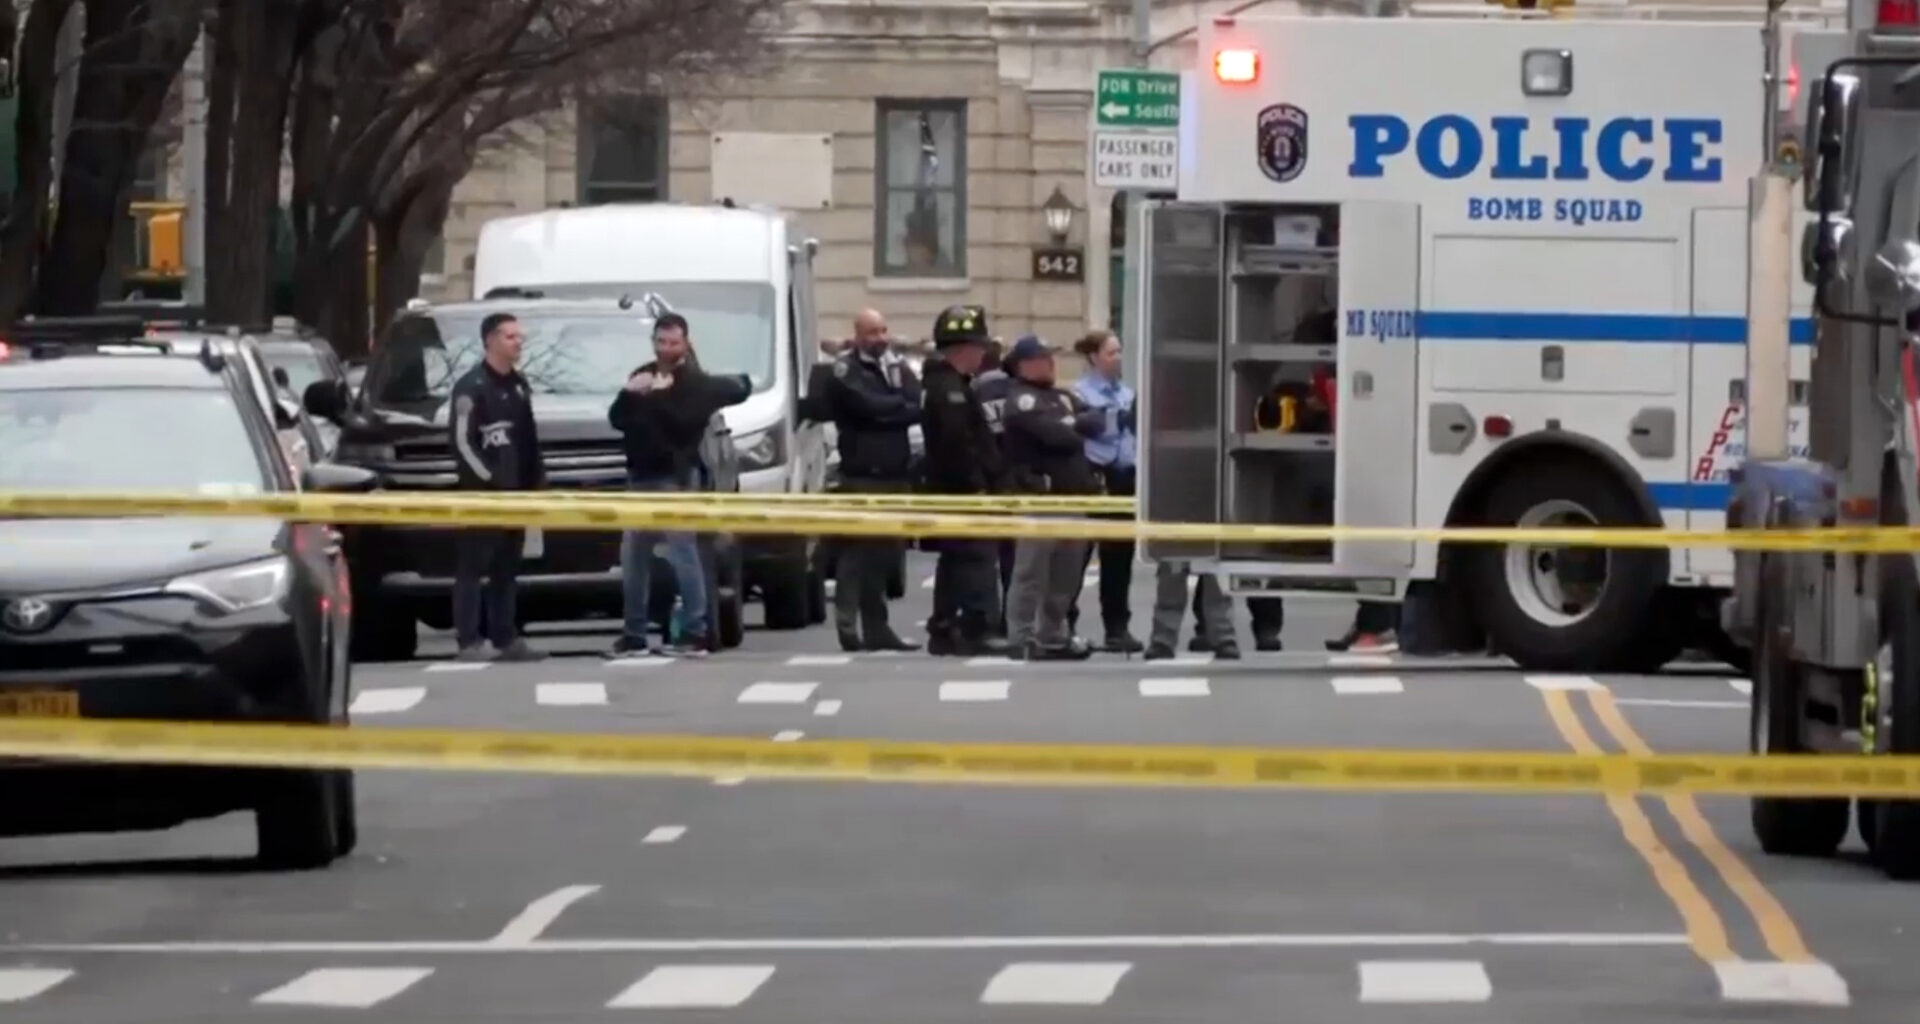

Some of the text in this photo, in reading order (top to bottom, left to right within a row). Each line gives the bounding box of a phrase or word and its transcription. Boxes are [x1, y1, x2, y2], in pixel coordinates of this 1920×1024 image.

[1101, 79, 1177, 95] FDR Drive
[1135, 103, 1179, 119] South
[1100, 139, 1174, 157] PASSENGER
[1348, 114, 1723, 182] POLICE
[1099, 161, 1173, 179] CARS ONLY
[1467, 197, 1643, 226] BOMB SQUAD
[1038, 255, 1079, 274] 542
[1369, 310, 1413, 343] SQUAD
